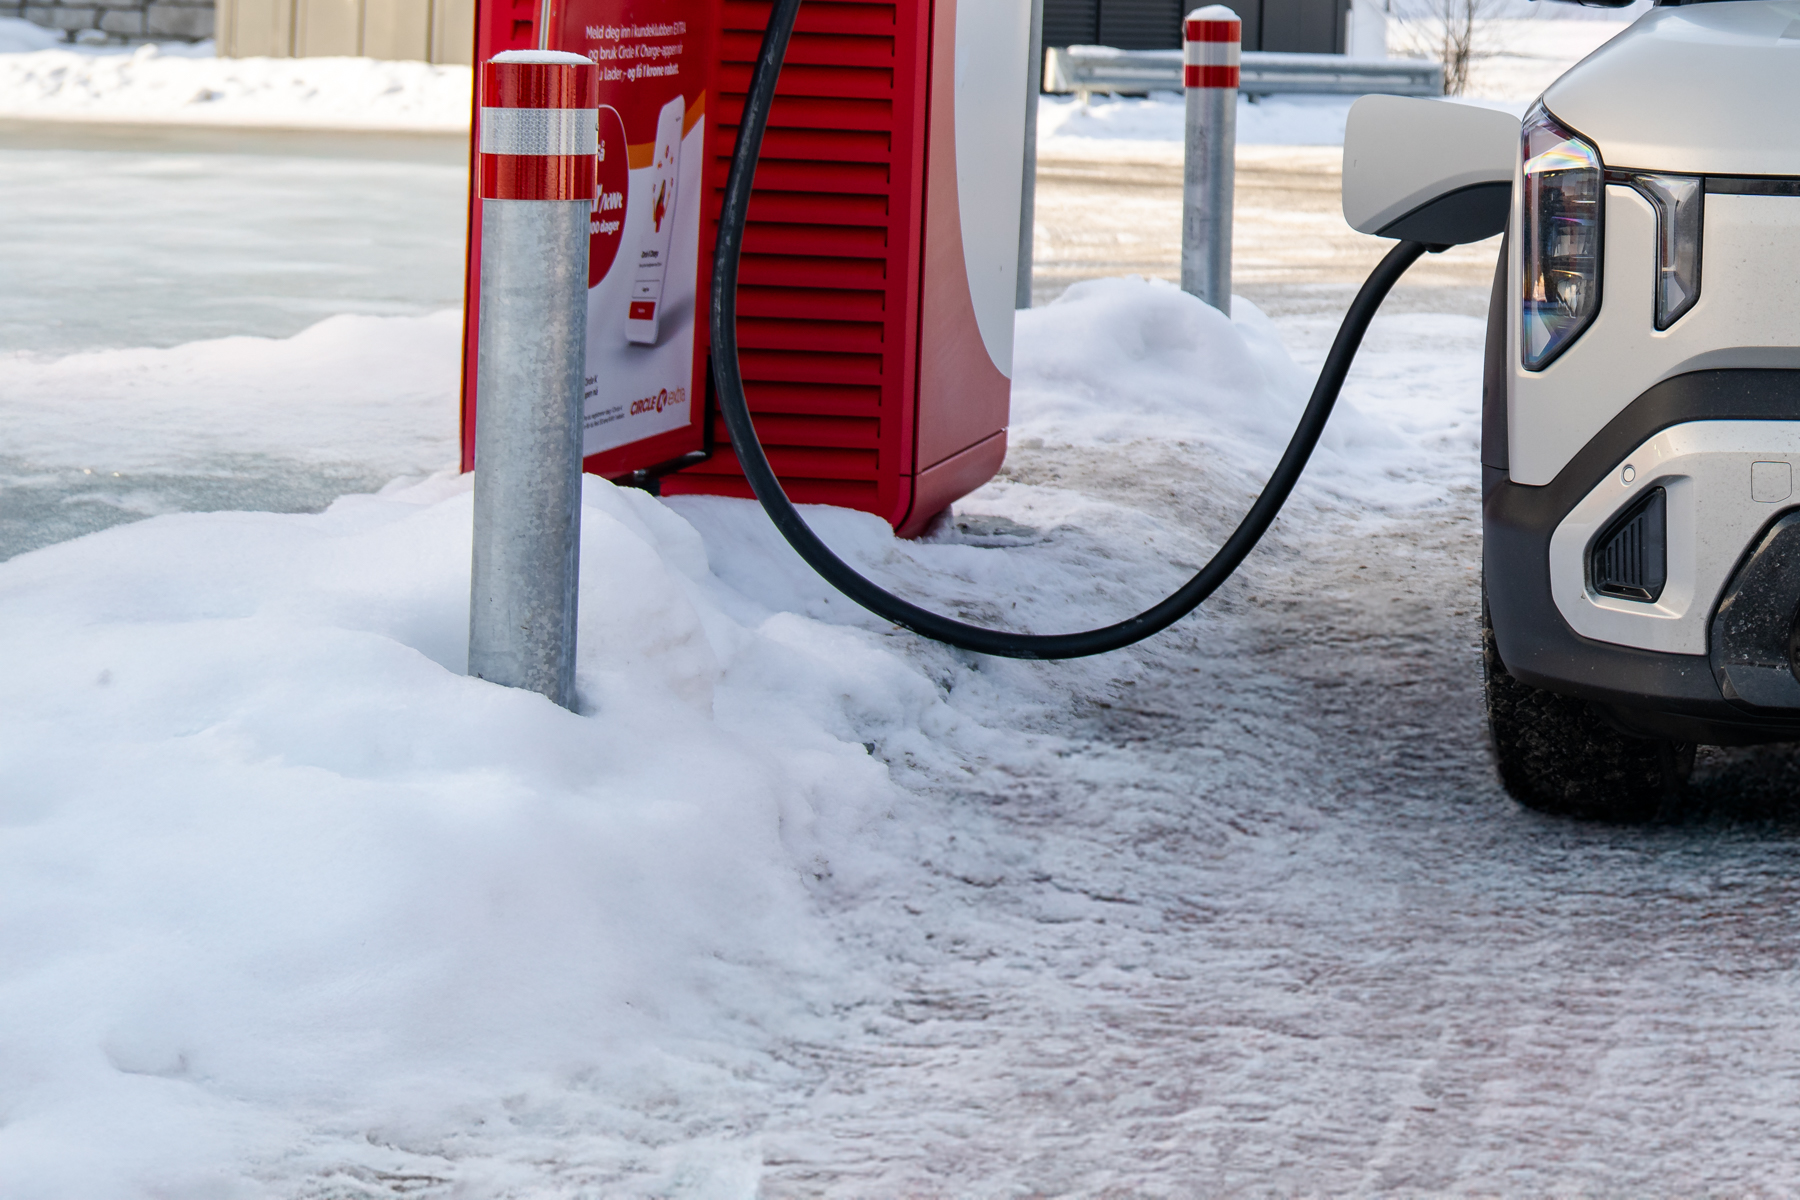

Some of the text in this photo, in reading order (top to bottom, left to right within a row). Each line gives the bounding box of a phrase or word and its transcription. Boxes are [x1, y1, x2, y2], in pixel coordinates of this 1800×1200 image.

[585, 25, 605, 40] Meld
[605, 24, 620, 42] deg
[599, 44, 617, 60] bruk
[600, 217, 620, 236] dager
[630, 395, 657, 416] CIRCLE
